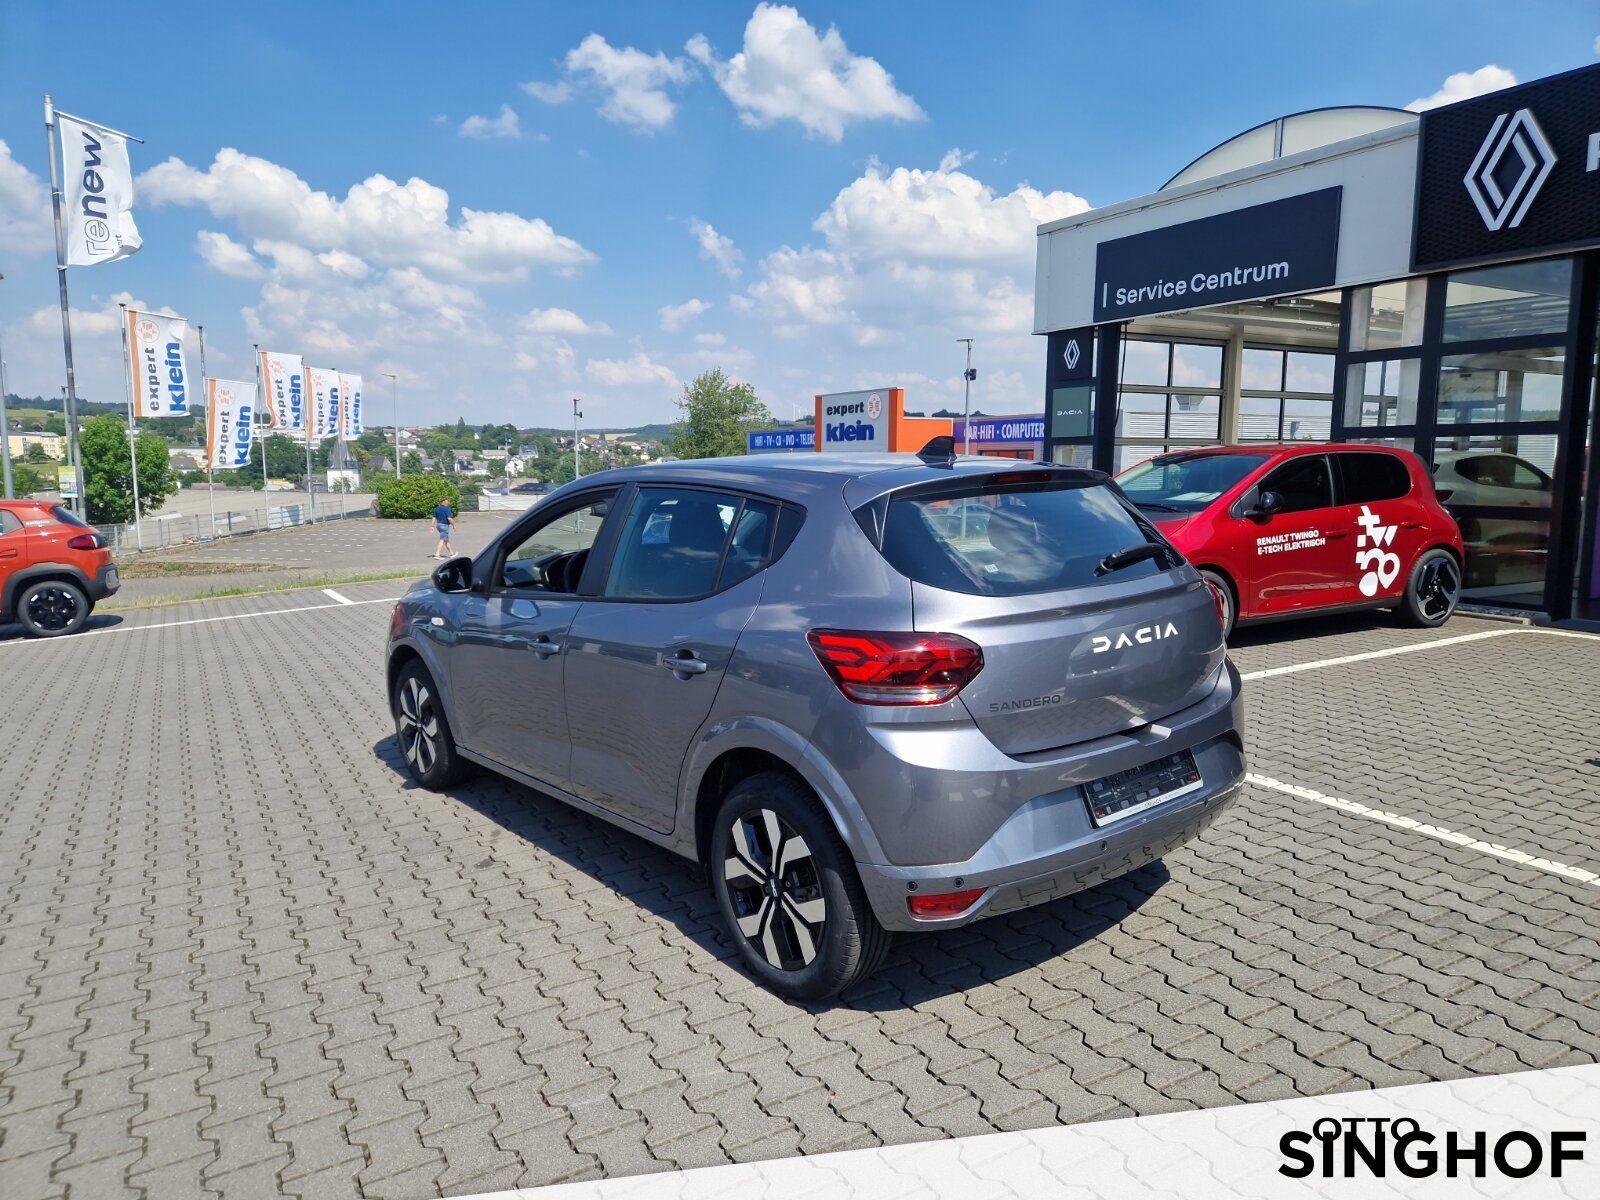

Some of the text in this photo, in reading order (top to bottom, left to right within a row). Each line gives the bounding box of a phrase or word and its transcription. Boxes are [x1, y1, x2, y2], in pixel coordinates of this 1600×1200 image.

[82, 131, 114, 255] renew
[1116, 261, 1289, 306] Service Centrum
[144, 347, 160, 412] expert
[165, 342, 187, 411] klein
[275, 379, 287, 426] expert
[289, 375, 301, 427] klein
[316, 392, 325, 435] expert
[328, 387, 339, 434] klein
[352, 392, 362, 435] klein
[826, 402, 865, 416] expert
[219, 411, 230, 465] expert
[234, 405, 252, 465] klein
[766, 435, 773, 446] TV
[826, 420, 874, 442] klein
[1001, 422, 1045, 438] COMPUTER
[1256, 530, 1319, 546] RENAULT TWINGO
[1257, 538, 1326, 555] E-TECH ELEKTRISCH
[1092, 622, 1179, 653] DACIA
[990, 694, 1061, 712] SANDERO
